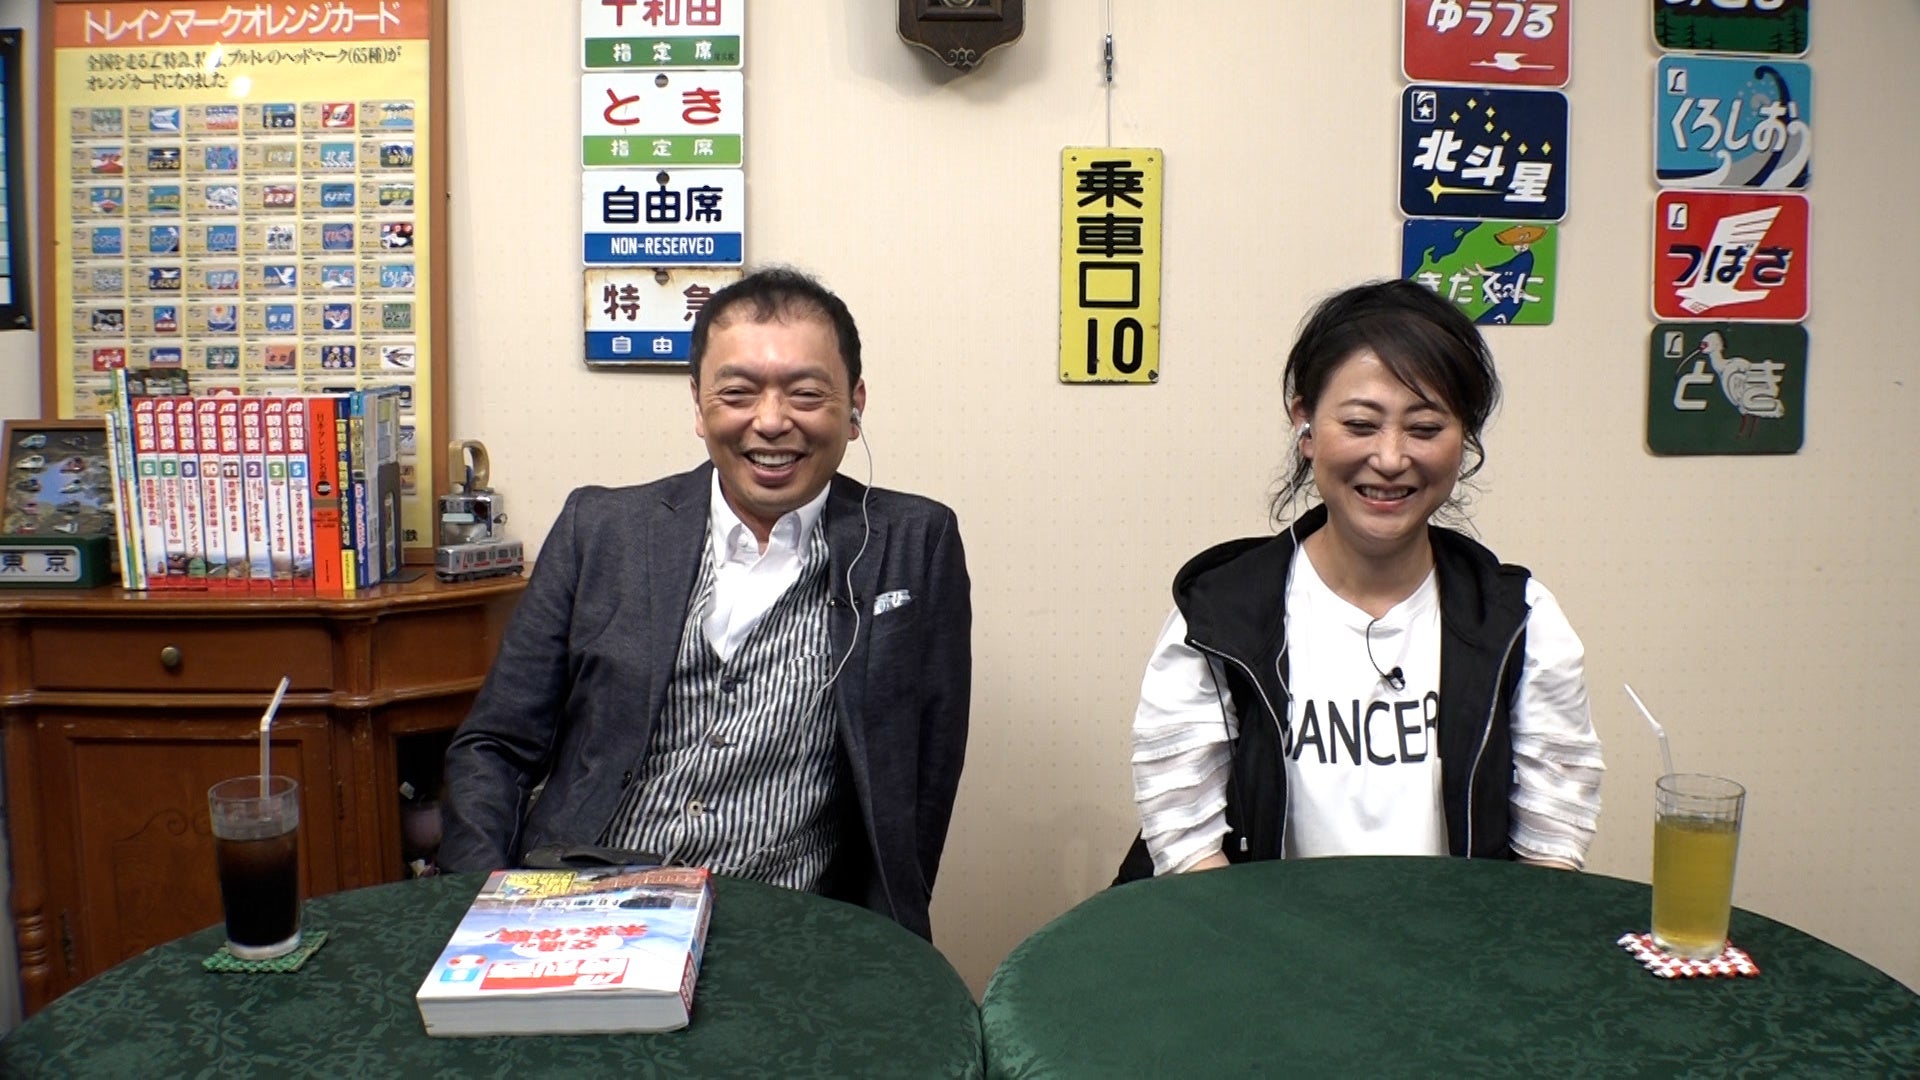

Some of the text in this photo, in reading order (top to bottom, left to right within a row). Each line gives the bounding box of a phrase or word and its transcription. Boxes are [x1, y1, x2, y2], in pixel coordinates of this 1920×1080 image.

[84, 0, 401, 44] トレインマークオレンジカード
[601, 0, 721, 27] 十和田
[612, 41, 713, 62] 指定席
[603, 87, 721, 126] とき
[1671, 98, 1797, 151] くろしお
[610, 138, 714, 157] 指定席
[1412, 128, 1552, 202] 北斗星
[603, 185, 723, 223] 自由席
[611, 237, 714, 255] NON-RESERVED
[1076, 160, 1144, 308] 乗車口
[1667, 243, 1793, 287] つばさ
[612, 336, 673, 355] 自由
[1087, 317, 1144, 375] 10
[1674, 359, 1786, 412] とき
[143, 463, 153, 475] 6
[164, 463, 173, 476] 8
[184, 463, 193, 476] 9
[203, 463, 218, 477] 10
[223, 464, 238, 476] 11
[248, 464, 258, 476] 2
[271, 464, 281, 476] 3
[1285, 691, 1439, 766] ANCER
